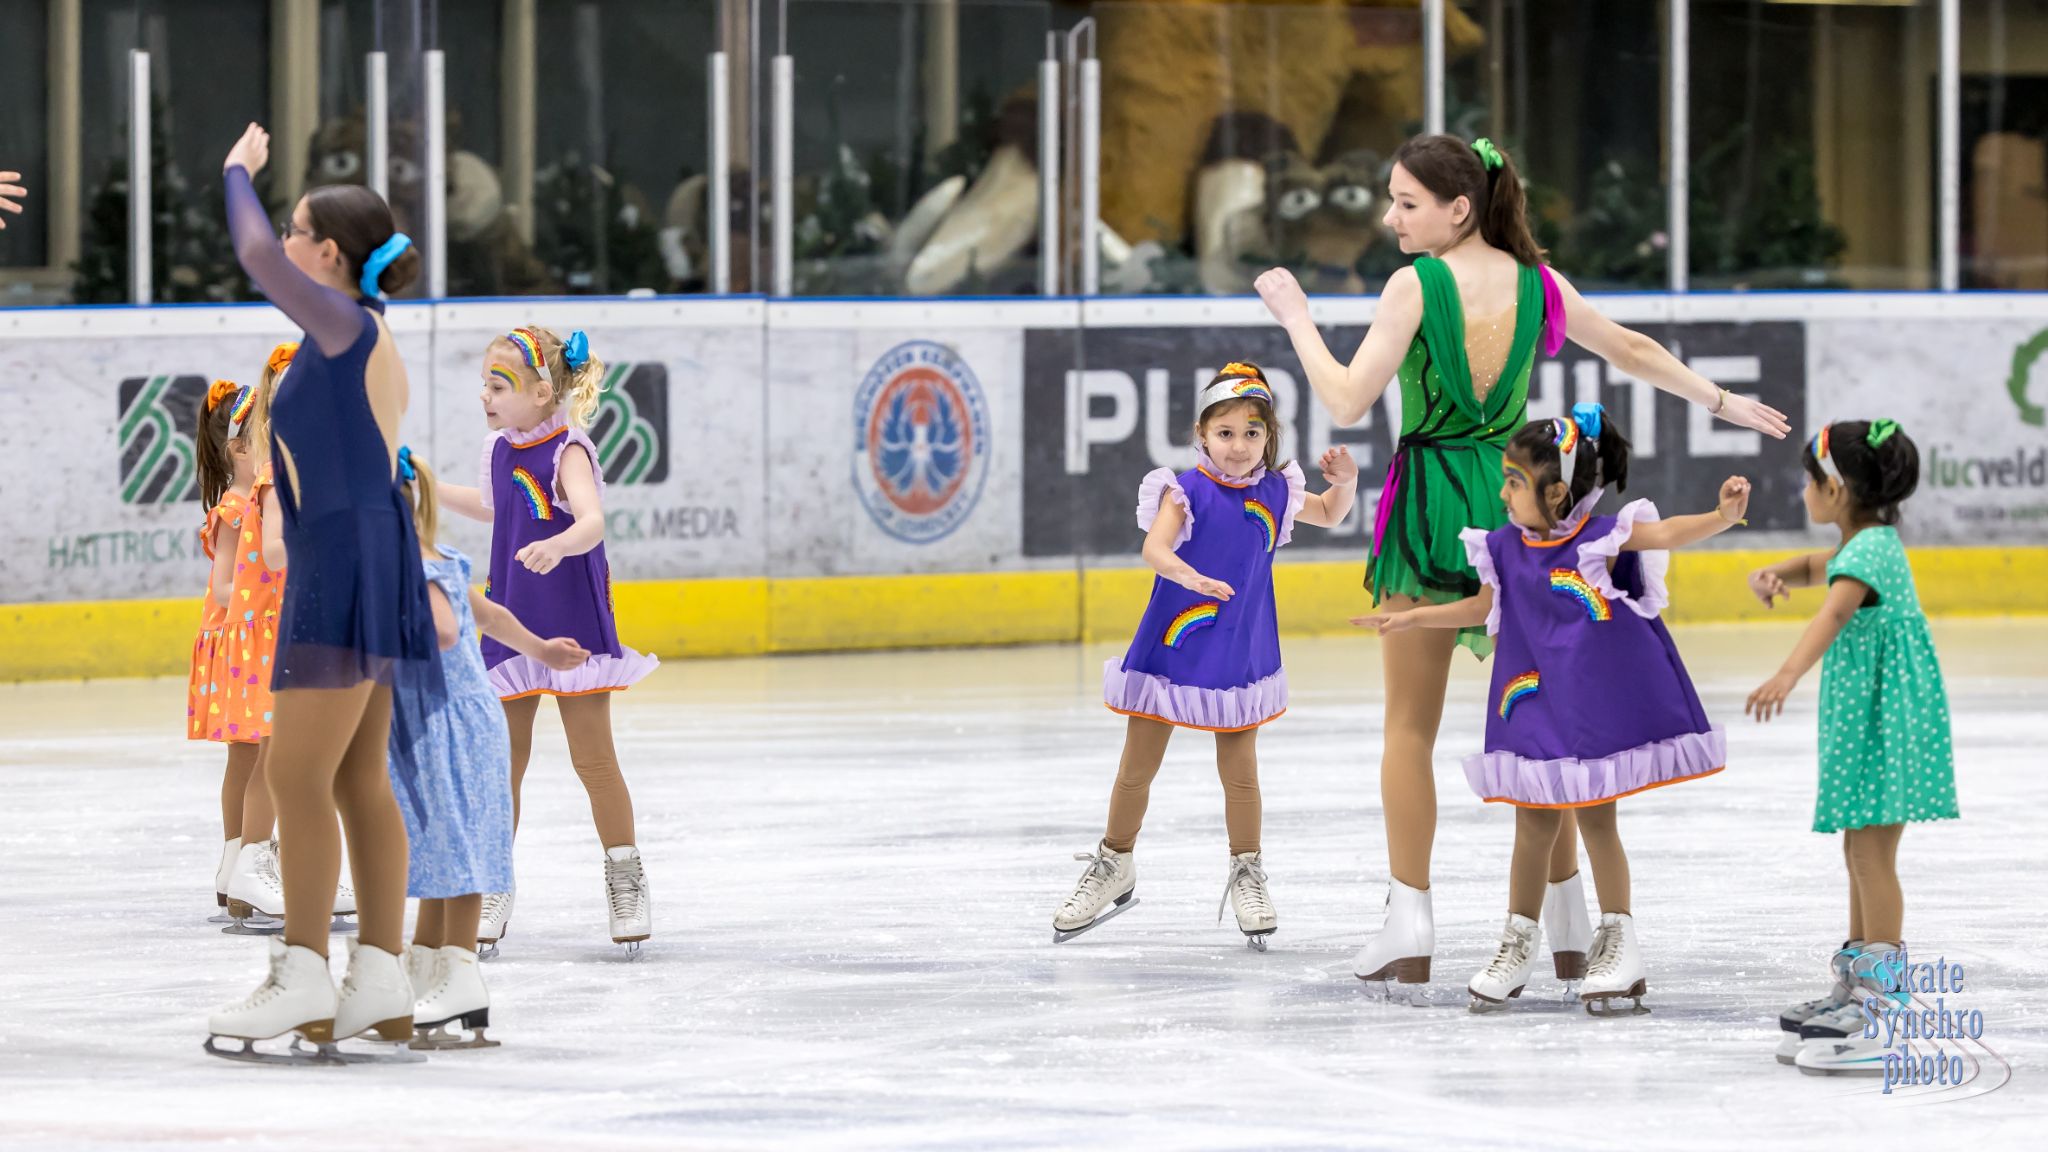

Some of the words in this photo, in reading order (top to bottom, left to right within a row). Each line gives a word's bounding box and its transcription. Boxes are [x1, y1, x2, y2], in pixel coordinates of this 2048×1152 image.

[1065, 356, 1761, 475] PUETE
[652, 507, 741, 540] MEDIA
[49, 528, 187, 567] HATTRICK
